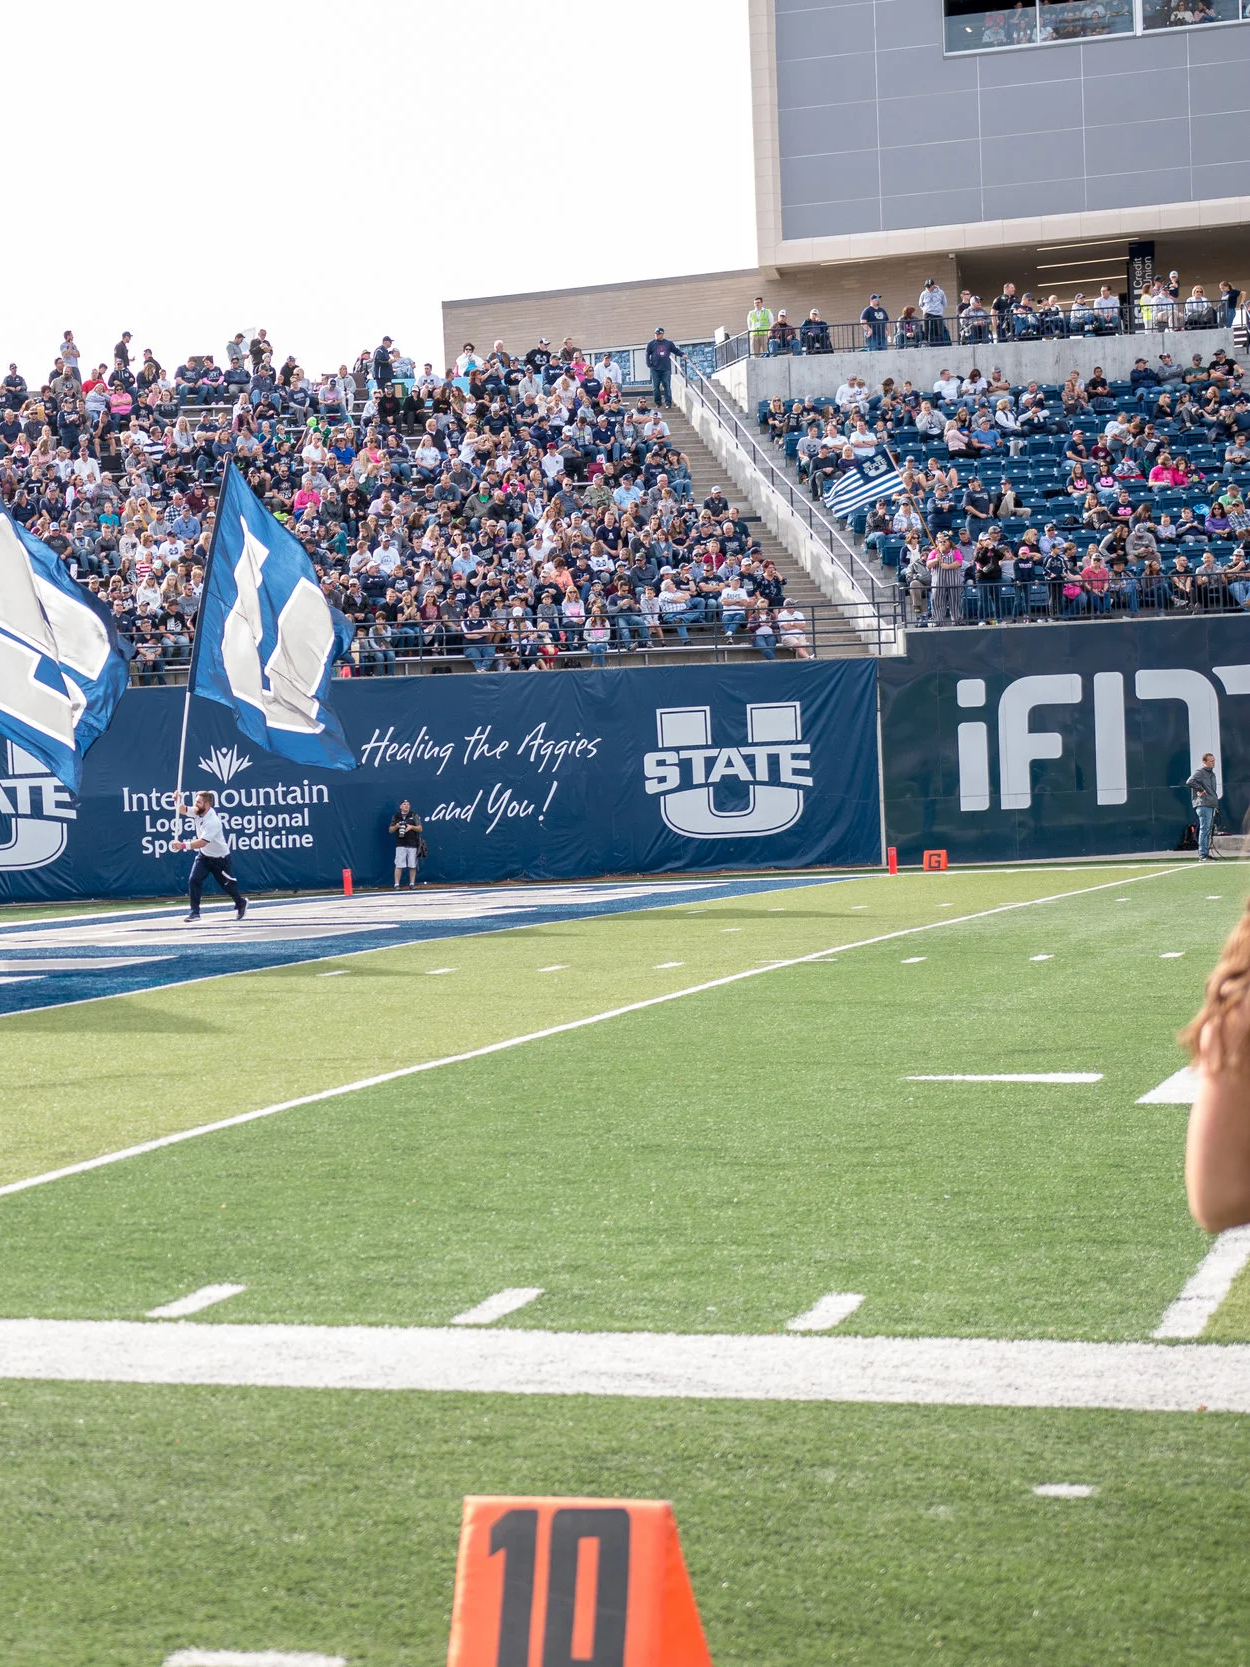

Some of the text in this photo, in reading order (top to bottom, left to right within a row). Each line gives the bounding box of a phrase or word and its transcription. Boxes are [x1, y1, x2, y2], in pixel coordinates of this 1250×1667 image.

[1133, 257, 1143, 287] Credit
[360, 721, 602, 776] Healing the Aggies
[643, 743, 813, 795] STATE
[655, 701, 805, 839] U
[145, 808, 310, 837] Loga Regional
[141, 830, 314, 858] Spo Medicine
[929, 854, 942, 868] G
[488, 1508, 631, 1667] 10
